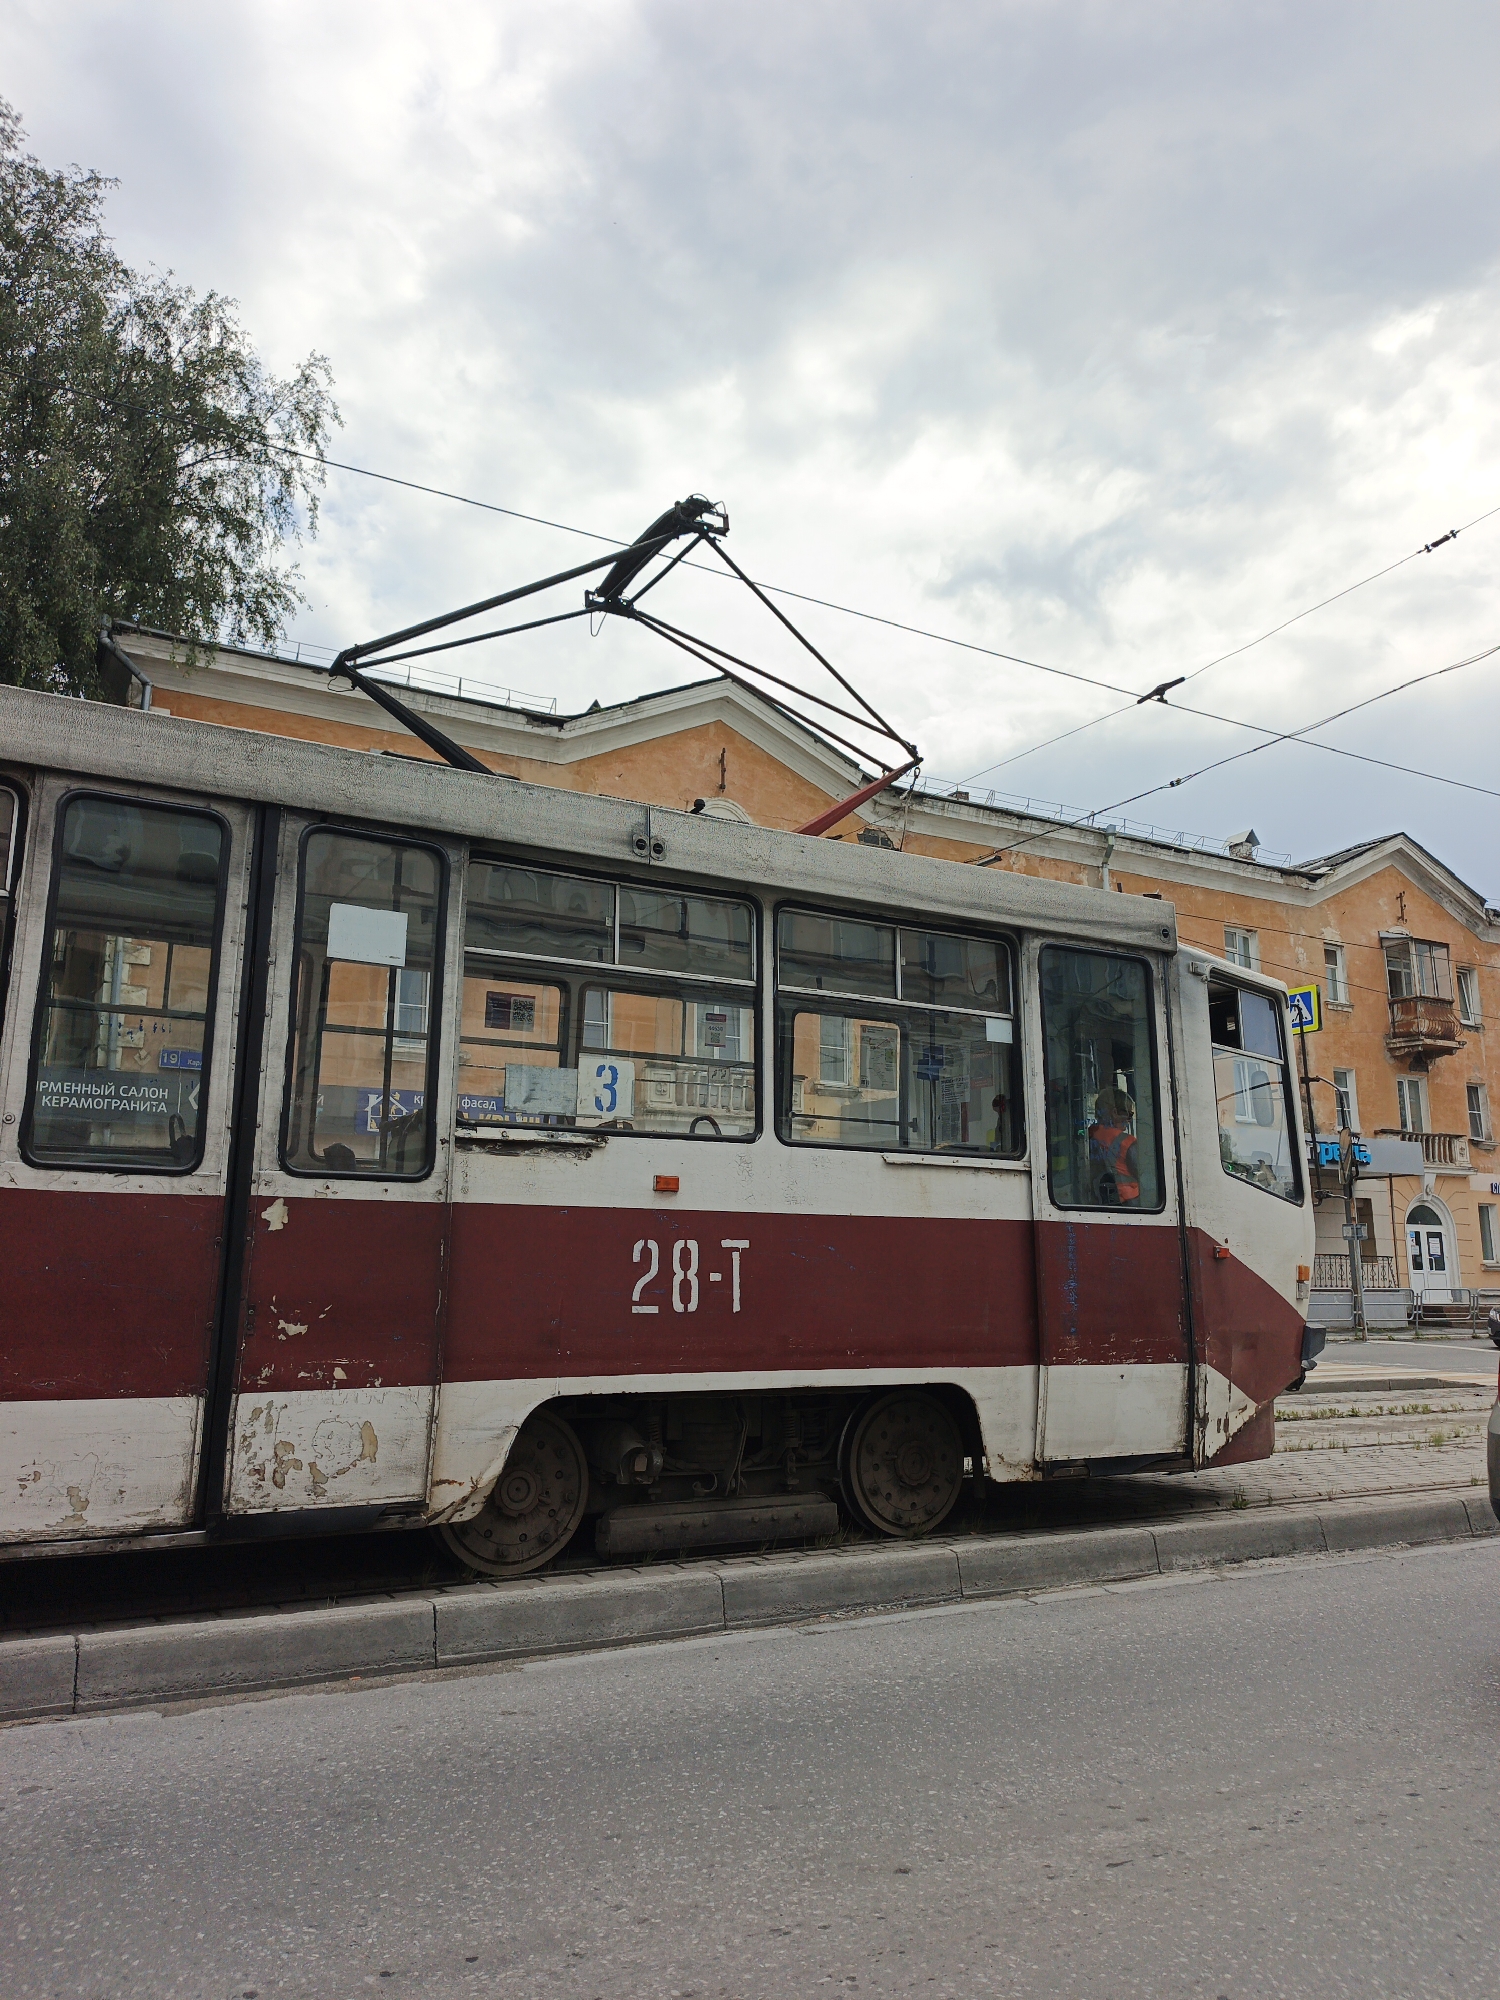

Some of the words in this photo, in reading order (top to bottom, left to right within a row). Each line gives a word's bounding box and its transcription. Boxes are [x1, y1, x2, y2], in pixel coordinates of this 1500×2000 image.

[163, 1052, 178, 1064] 19
[119, 1085, 169, 1099] САЛОН
[594, 1064, 619, 1113] 3
[41, 1095, 168, 1113] КЕРАМОГРАНИТА
[461, 1096, 497, 1111] фасад
[631, 1239, 750, 1314] 28-Т
